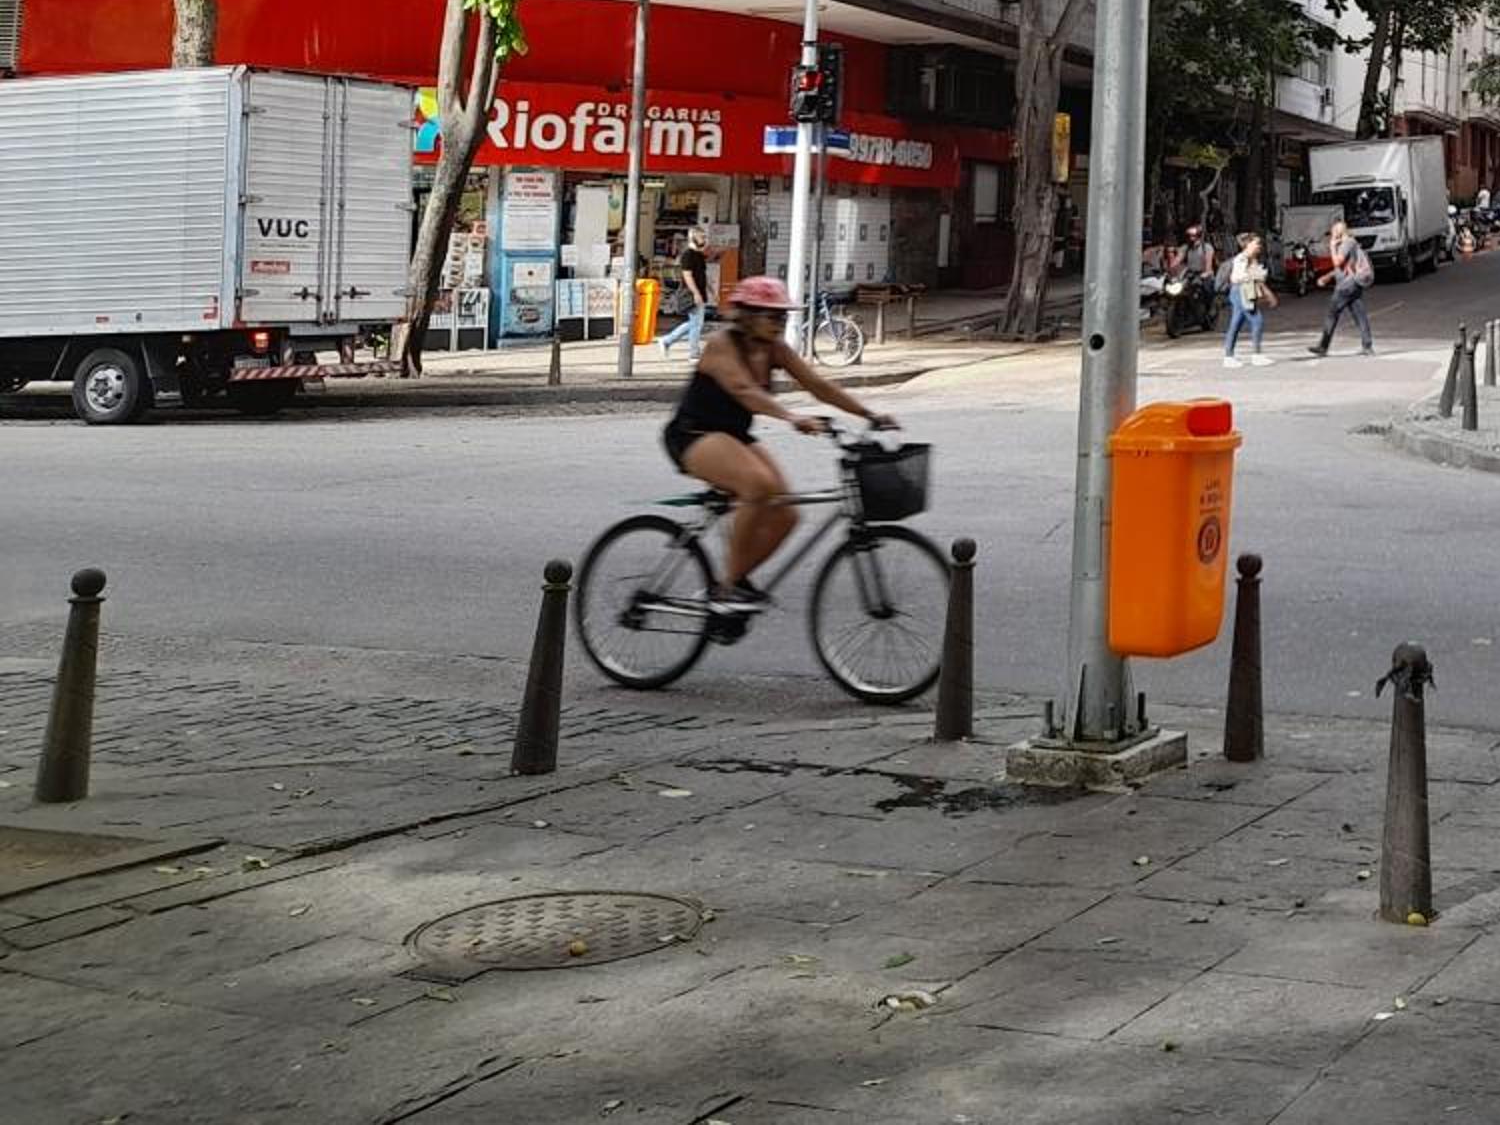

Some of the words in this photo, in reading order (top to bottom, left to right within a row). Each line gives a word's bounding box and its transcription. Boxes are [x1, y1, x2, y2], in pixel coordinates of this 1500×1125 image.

[597, 102, 722, 123] DRGARIAS
[486, 98, 723, 158] Riofama
[257, 218, 309, 238] VUC
